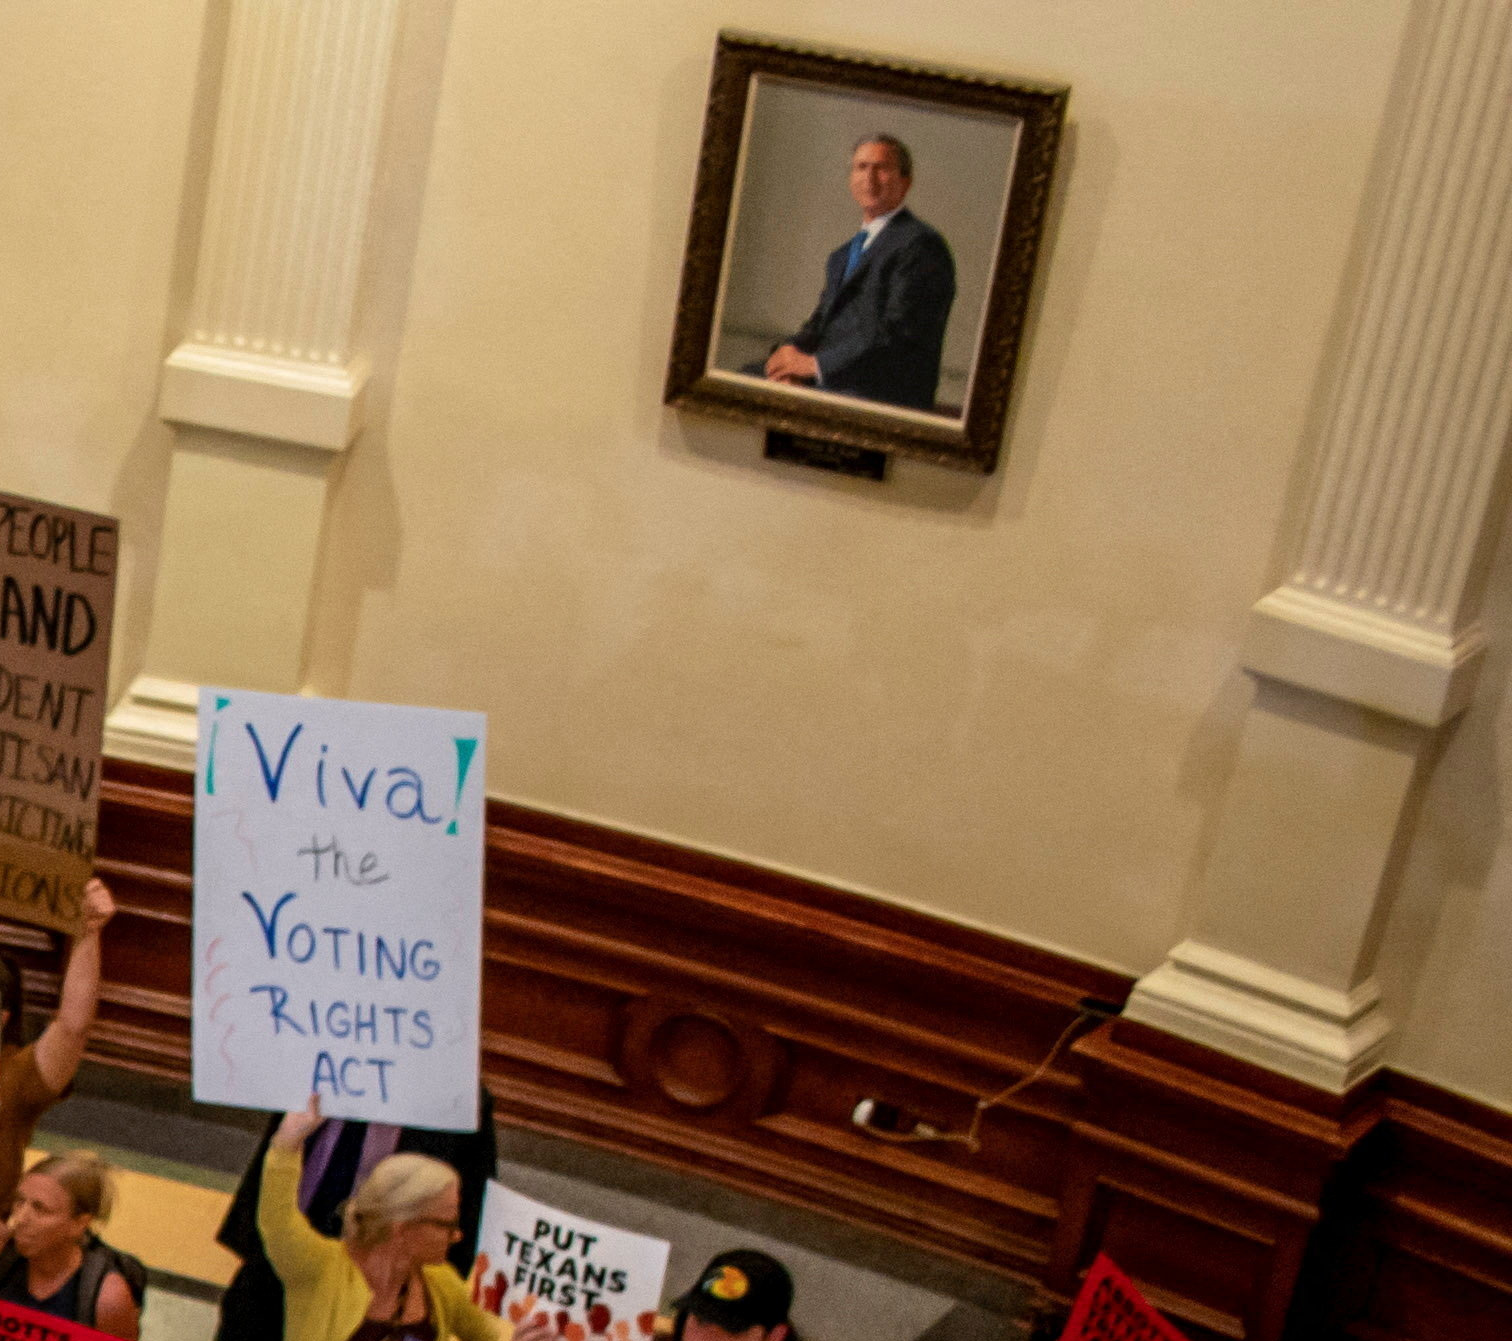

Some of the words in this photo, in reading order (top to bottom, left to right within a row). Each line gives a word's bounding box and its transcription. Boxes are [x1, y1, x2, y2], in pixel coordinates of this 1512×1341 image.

[298, 835, 389, 885] the
[242, 892, 441, 982] VOTING
[250, 986, 436, 1048] RIGHTS
[311, 1050, 396, 1102] ACT
[504, 1231, 627, 1293] TEXANS
[533, 1219, 597, 1258] PUT
[512, 1266, 598, 1309] FIRST
